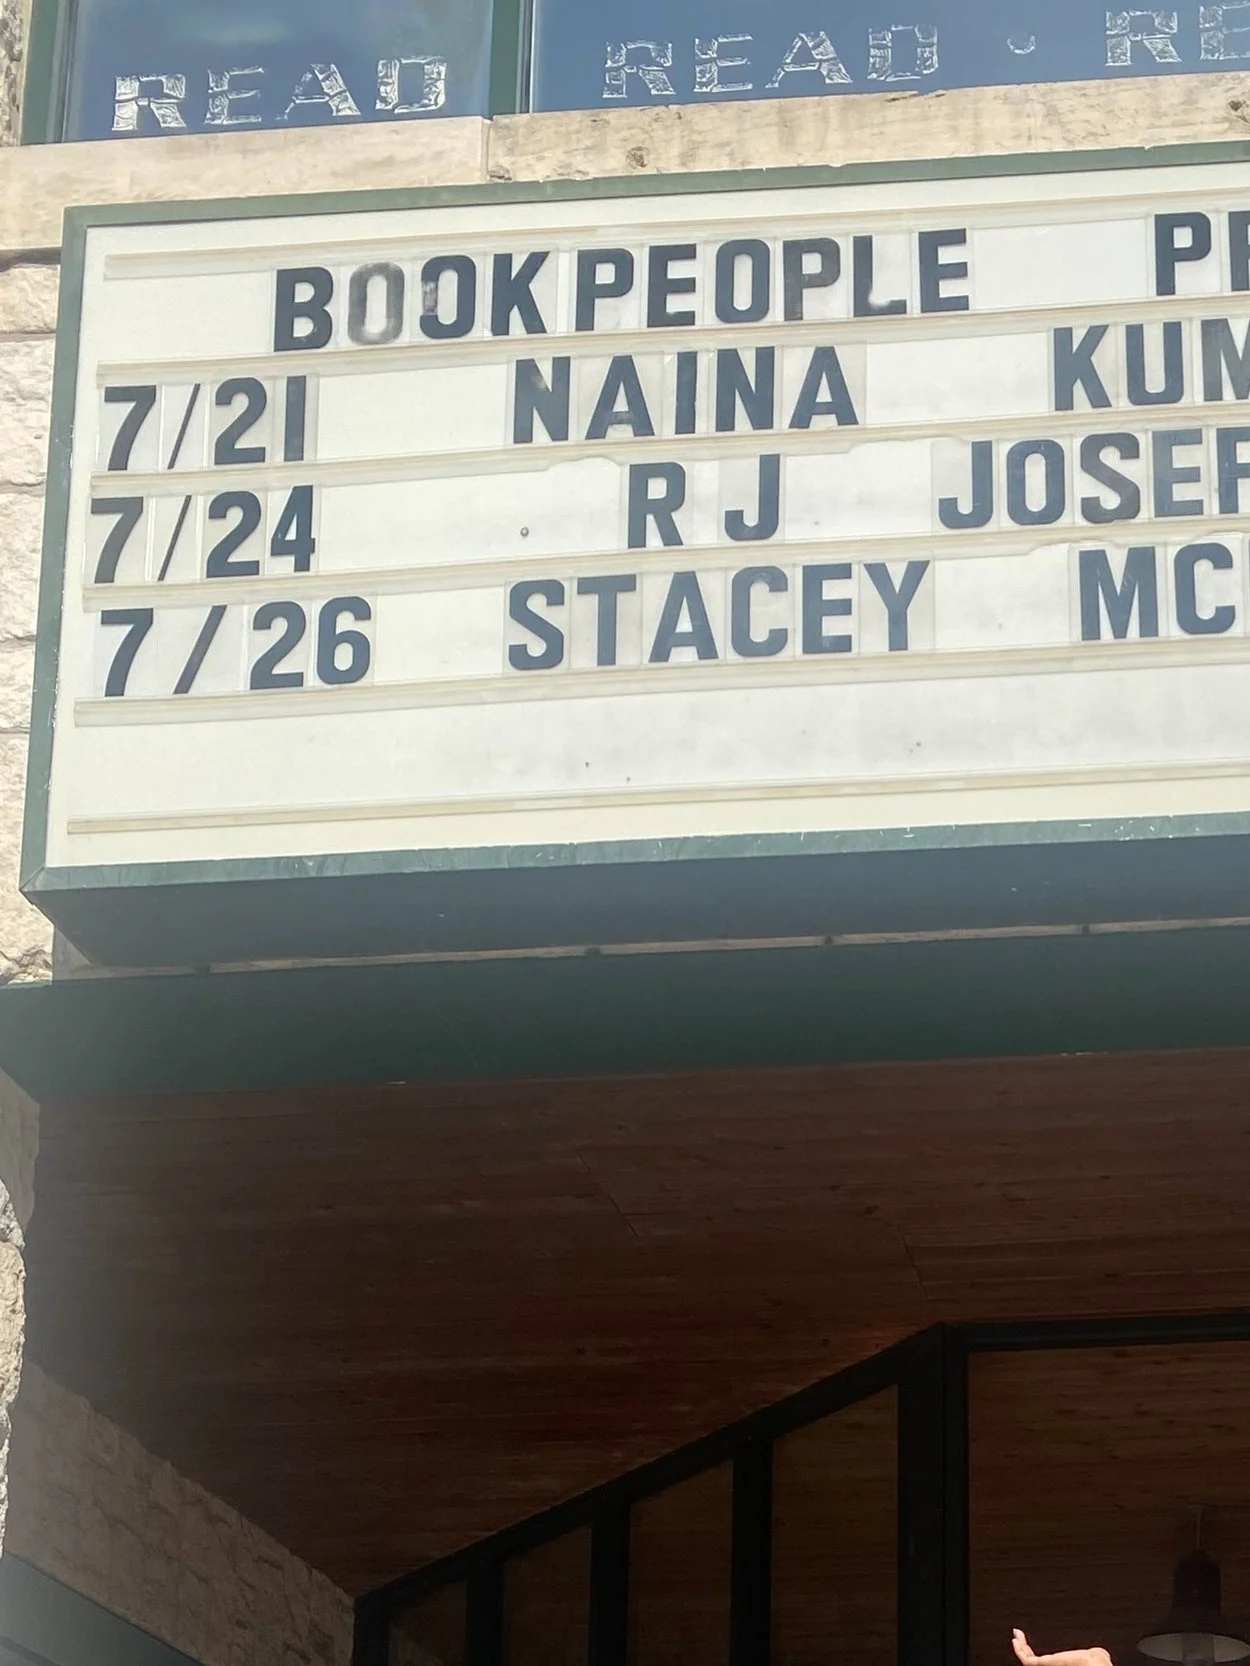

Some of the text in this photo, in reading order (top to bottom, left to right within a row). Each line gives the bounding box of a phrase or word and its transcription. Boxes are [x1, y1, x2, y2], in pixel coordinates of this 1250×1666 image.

[112, 55, 447, 132] READ
[602, 25, 938, 99] READ
[274, 228, 970, 352] BOOKPEOPLE
[103, 375, 307, 471] 7/21
[513, 345, 860, 444] NAINA
[90, 485, 316, 584] 7/24
[100, 596, 372, 697] 7/26
[508, 560, 930, 670] STACEY
